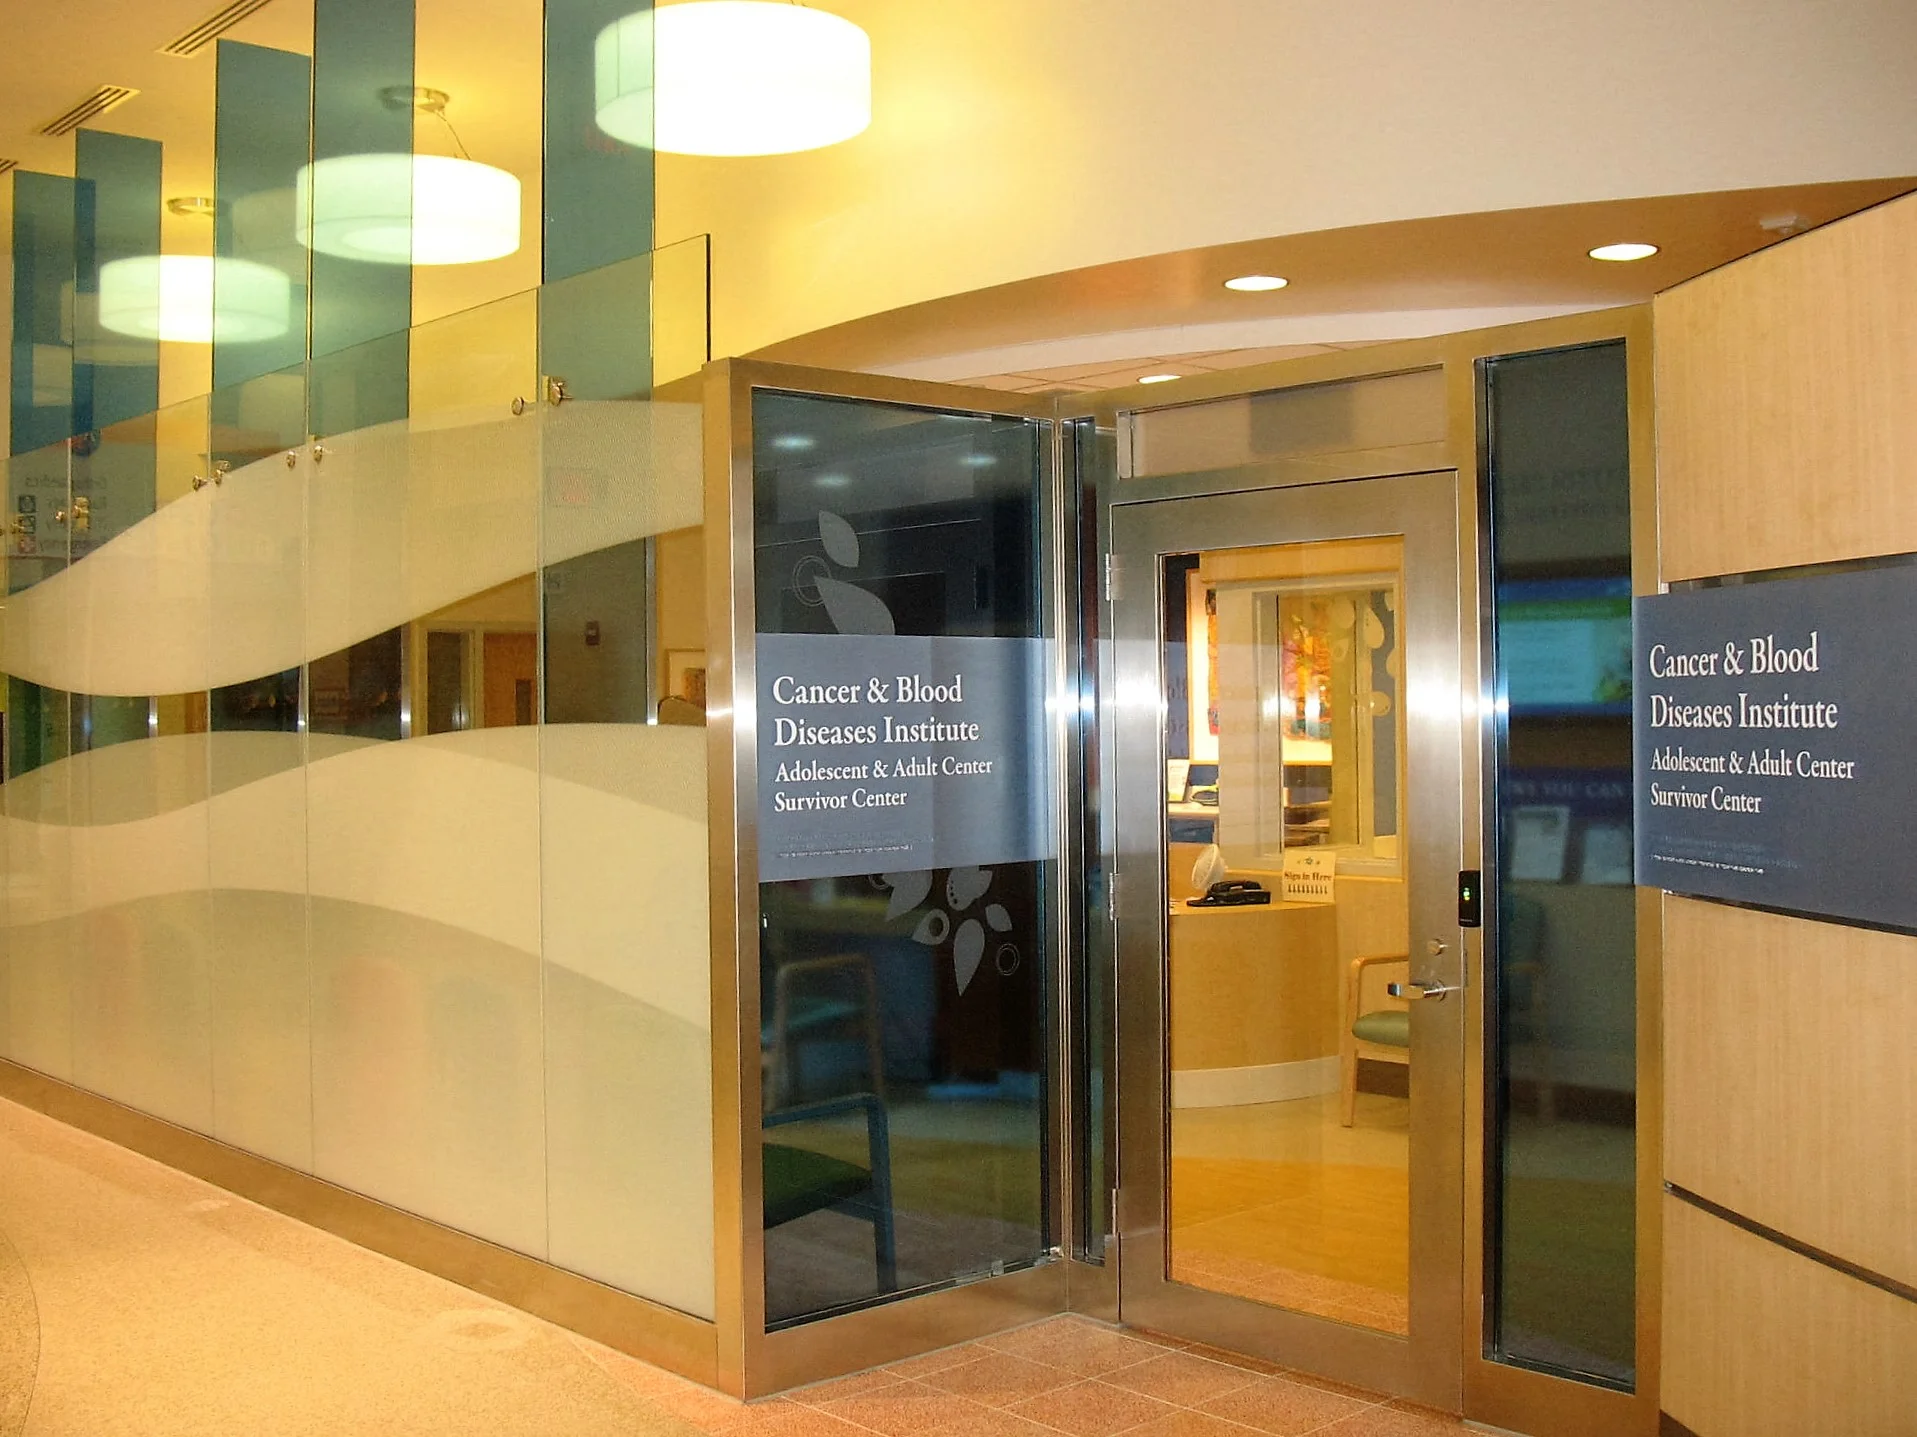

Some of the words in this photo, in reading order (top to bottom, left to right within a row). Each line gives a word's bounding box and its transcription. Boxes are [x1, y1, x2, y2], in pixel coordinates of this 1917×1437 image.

[1650, 644, 1719, 678] Cancer
[1723, 641, 1744, 676] &
[1750, 631, 1819, 674] Blood
[773, 675, 861, 705] Cancer
[867, 677, 889, 703] &
[896, 674, 963, 703] Blood
[1651, 694, 1733, 728] Diseases
[1738, 692, 1838, 728] Institute
[774, 717, 877, 747] Diseases
[883, 715, 979, 743] Institute
[774, 760, 868, 783] Adolescent
[873, 760, 888, 779] &
[892, 757, 938, 777] Adult
[941, 756, 993, 776] Center
[1651, 746, 1726, 774] Adolescent
[1729, 751, 1745, 775] &
[1747, 748, 1793, 778] Adult
[1796, 751, 1855, 780] Center
[774, 791, 848, 813] Survivor
[851, 788, 908, 808] Center
[1651, 783, 1708, 810] Survivor
[1711, 786, 1762, 814] Center
